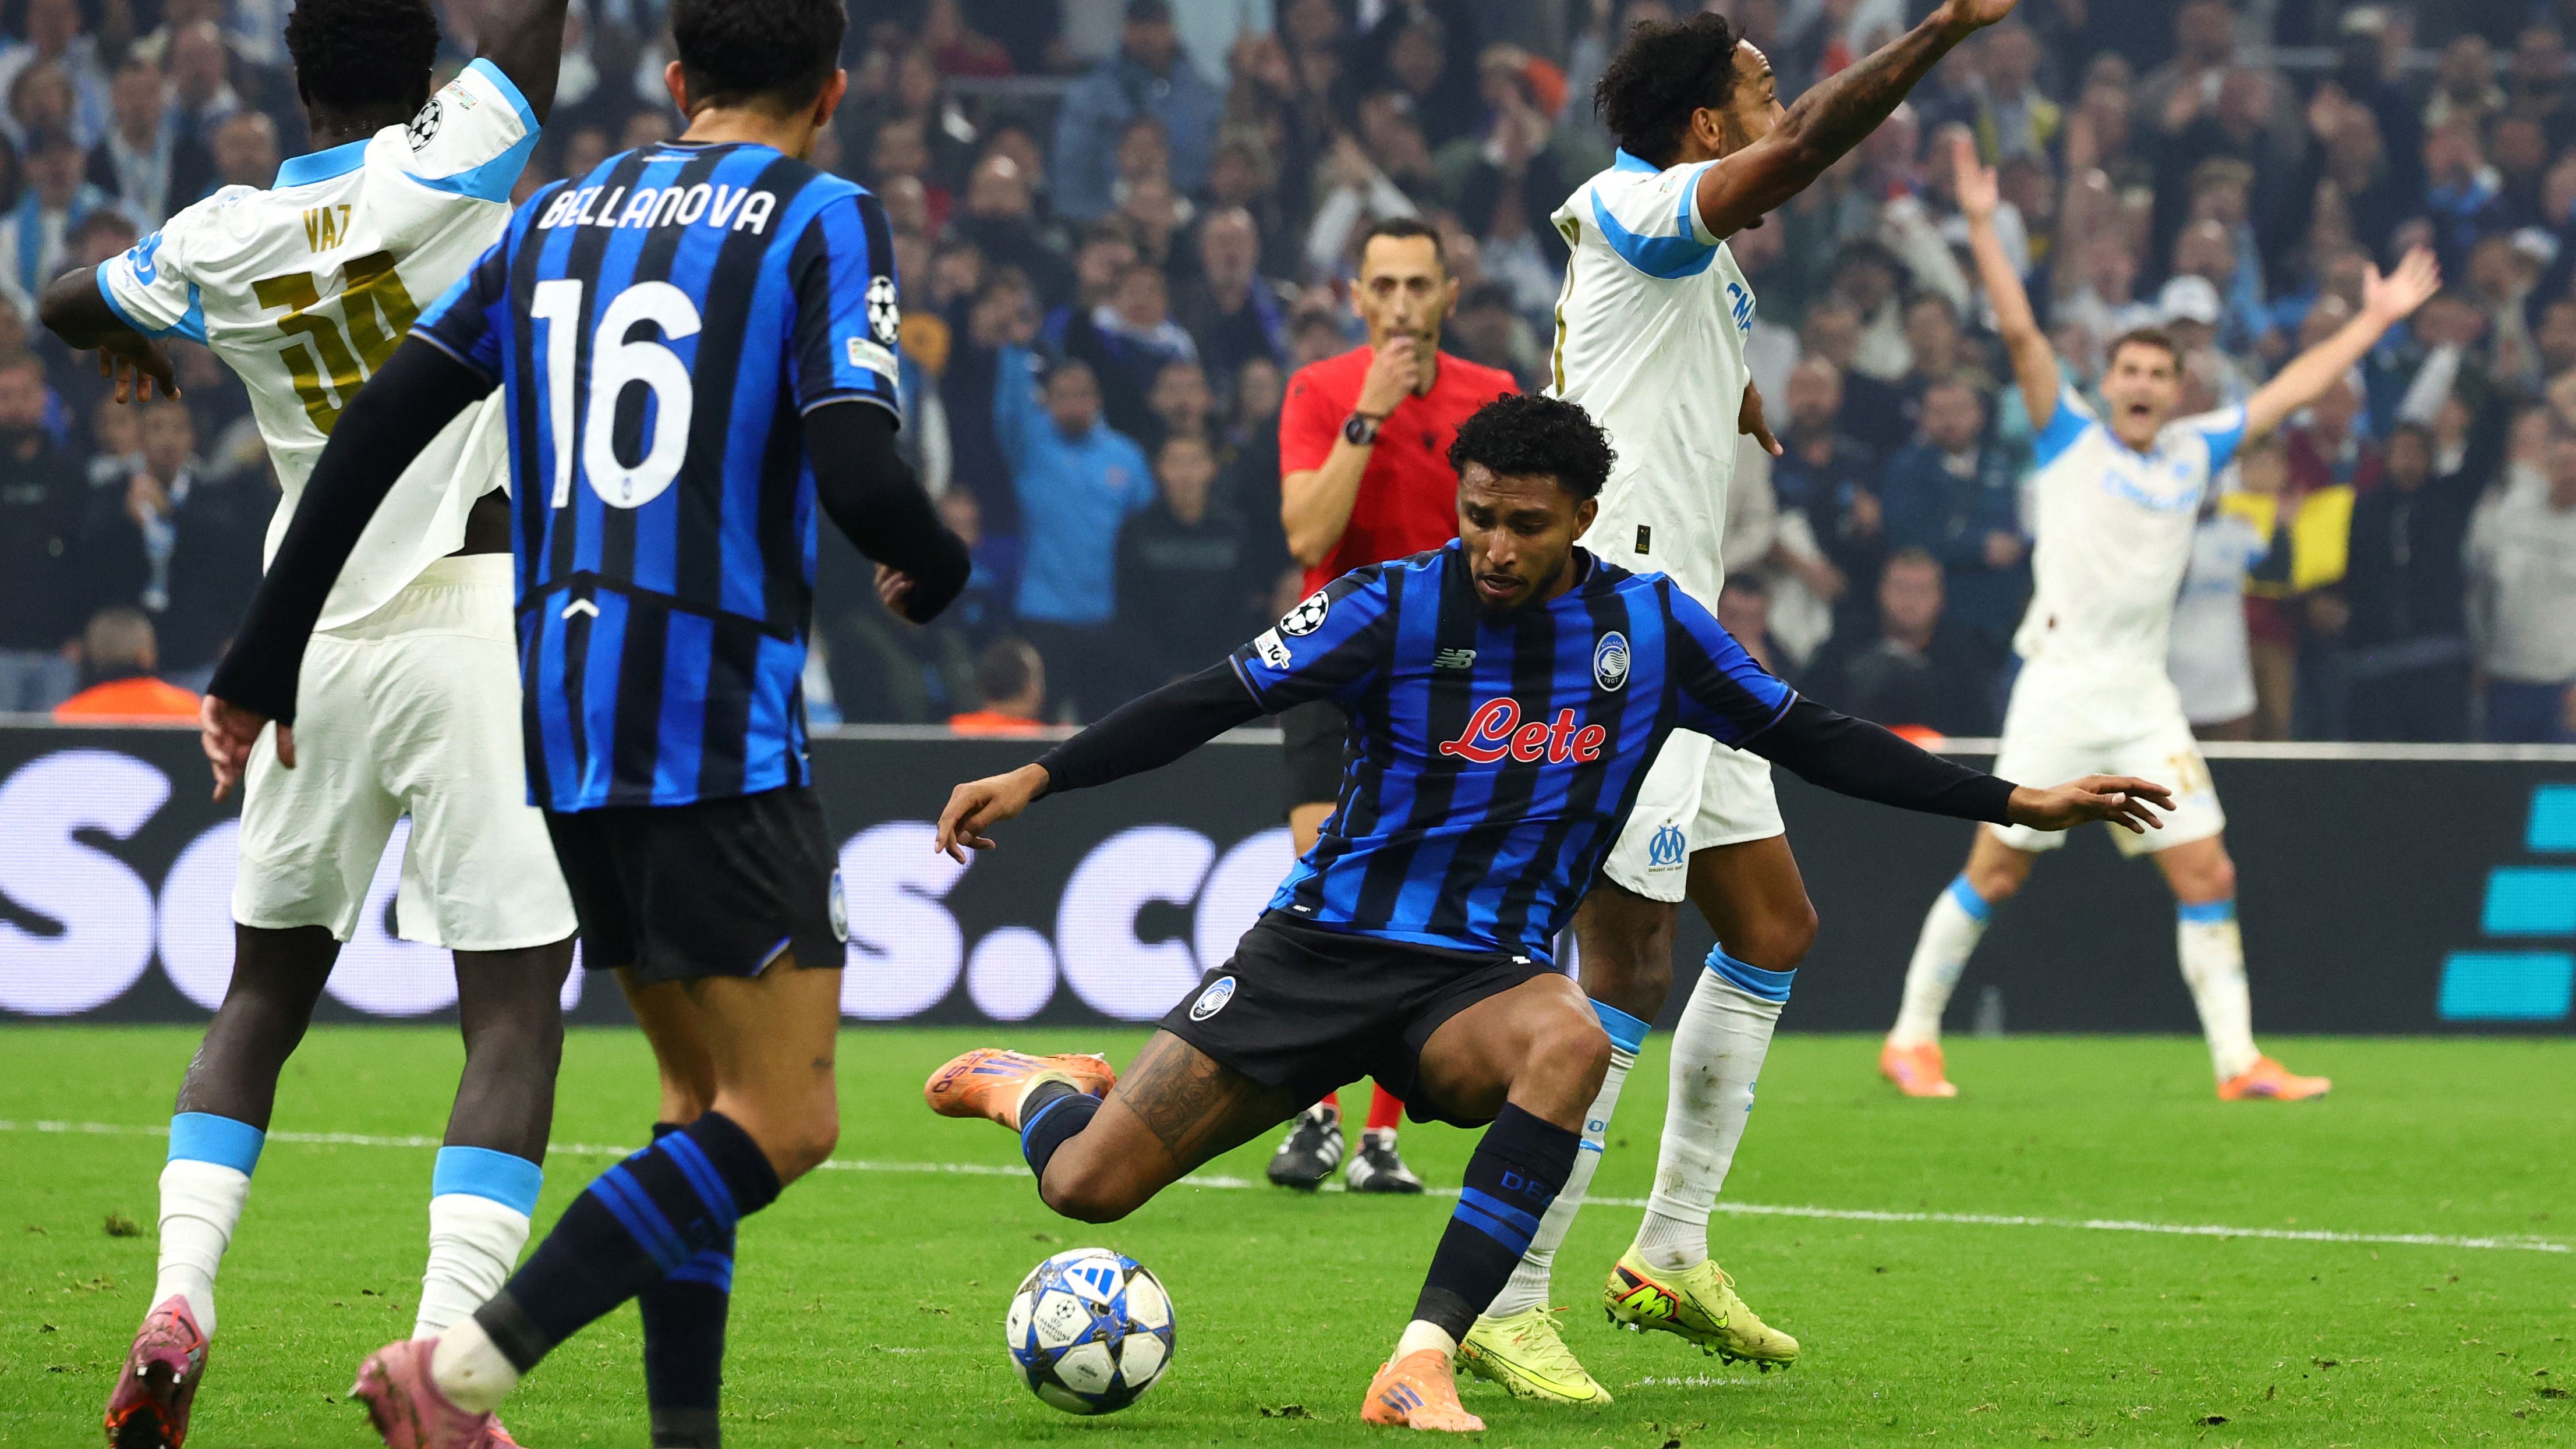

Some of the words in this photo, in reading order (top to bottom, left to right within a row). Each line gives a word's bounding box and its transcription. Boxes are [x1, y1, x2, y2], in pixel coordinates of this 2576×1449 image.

[303, 204, 351, 253] VAZ
[537, 183, 776, 234] BELLANOVA
[530, 278, 702, 509] 16
[1439, 697, 1606, 764] Lete
[1036, 1315, 1071, 1342] CHAMPIONS
